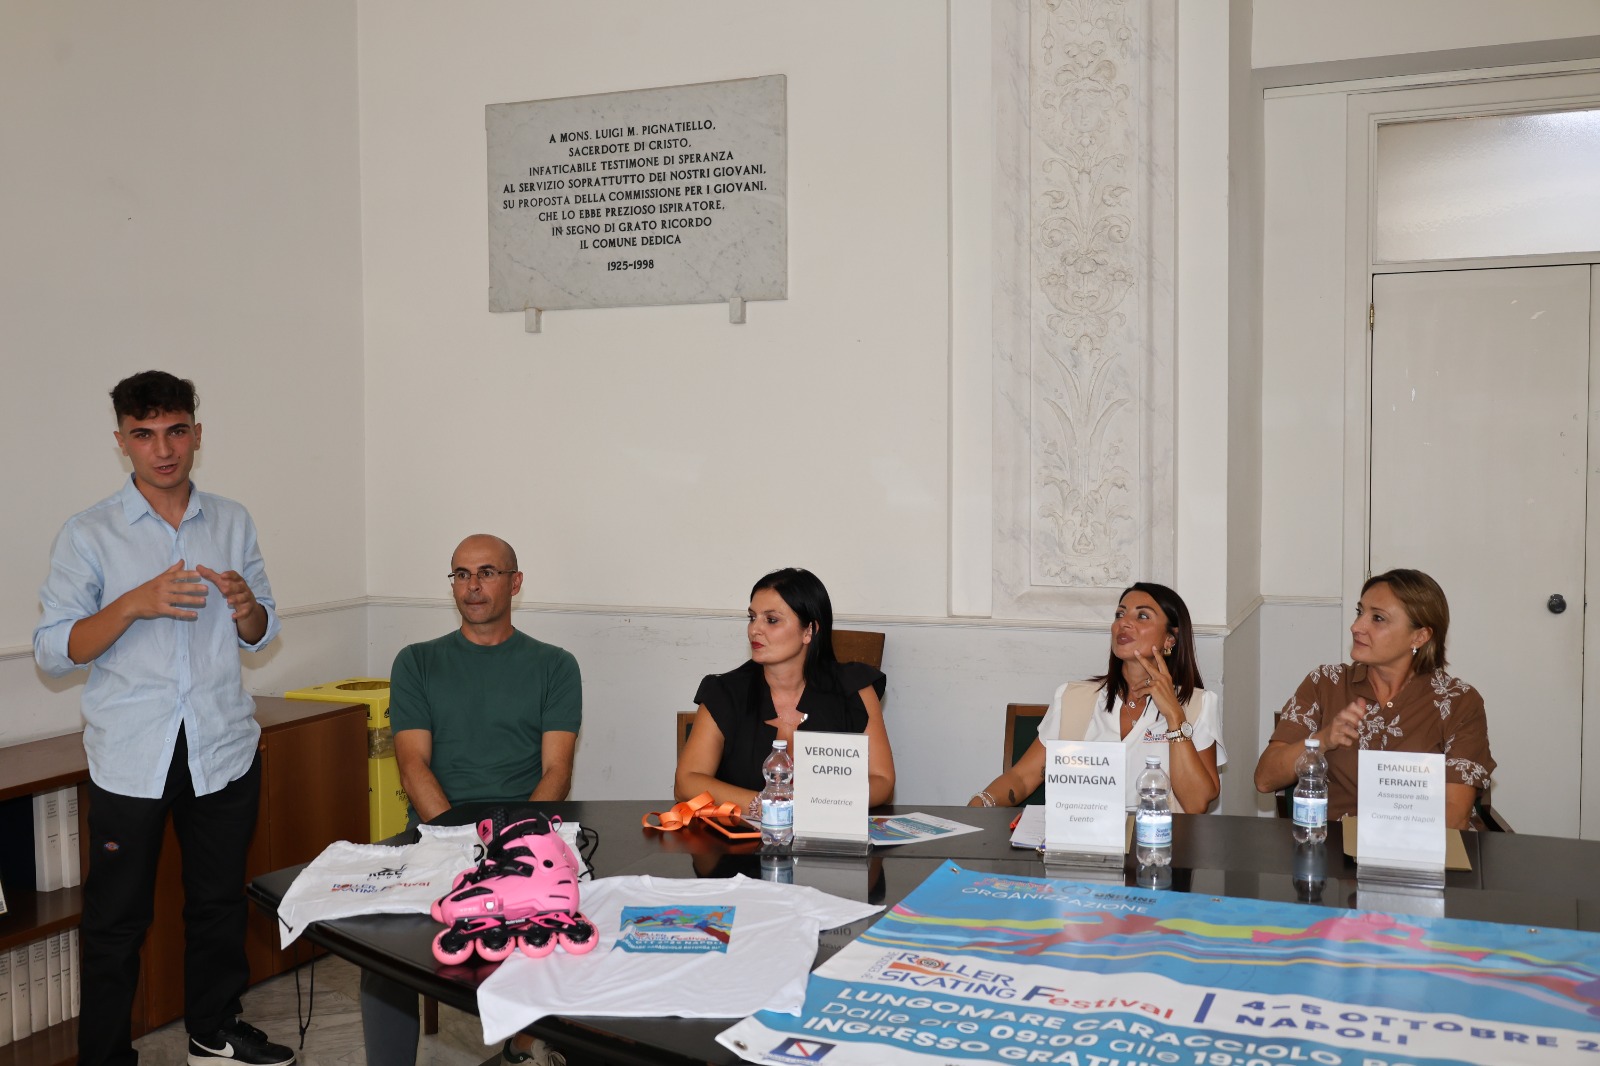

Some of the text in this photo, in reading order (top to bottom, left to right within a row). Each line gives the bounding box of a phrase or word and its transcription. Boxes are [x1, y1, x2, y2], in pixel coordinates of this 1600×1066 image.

[549, 119, 716, 144] A MONS. LUIGI M. PIGNATIELLO,
[568, 138, 692, 157] SACERDOTE DI CRISTO,
[529, 151, 734, 177] INFATICABILE TESTIMONE DI SPERANZA
[503, 184, 516, 194] AL
[519, 180, 565, 193] SERVIZIO
[568, 173, 645, 189] SOPRATTUTTO
[649, 172, 666, 183] DEI
[670, 168, 710, 181] NOSTRI
[503, 200, 515, 210] SU
[518, 196, 570, 209] PROPOSTA
[574, 193, 606, 205] DELLA
[608, 187, 681, 202] COMMISSIONE
[685, 185, 703, 196] PER
[706, 184, 710, 195] I
[538, 212, 558, 222] CHE
[562, 210, 576, 220] LO
[579, 209, 602, 219] EBBE
[605, 204, 656, 218] PREZIOSO
[552, 217, 712, 237] IN SEGNO DI GRATO RICORDO
[580, 235, 681, 250] IL COMUNE DEDICA
[607, 260, 655, 272] 1925-1998
[804, 746, 860, 758] VERONICA
[1054, 755, 1110, 767] ROSSELLA
[812, 765, 852, 776] CAPRIO
[1377, 763, 1430, 774] EMANUELA
[1047, 774, 1116, 786] MONTAGNA
[1379, 777, 1428, 788] FERRANTE
[810, 797, 853, 806] Moderatrice
[1377, 791, 1414, 800] Assessore
[1055, 801, 1108, 811] Organizzatrice
[1393, 802, 1413, 810] Sport
[1069, 815, 1095, 823] Evento
[1371, 812, 1402, 821] Comune
[1411, 815, 1436, 824] Napoli
[962, 887, 1149, 914] ORGANIZZAZIONE
[896, 951, 1015, 987] ROLLER
[878, 969, 1174, 1019] SKATING Festival
[821, 1001, 910, 1024] Dalle
[920, 1019, 979, 1034] ore
[989, 1024, 1099, 1047] 09:00
[1109, 1039, 1181, 1063] alle
[837, 987, 1342, 1066] LUNGOMARE CARACCIOLO
[1235, 1004, 1408, 1045] NAPOLI
[1339, 1012, 1559, 1048] OTTOBRE
[802, 1016, 991, 1053] INGRESSO
